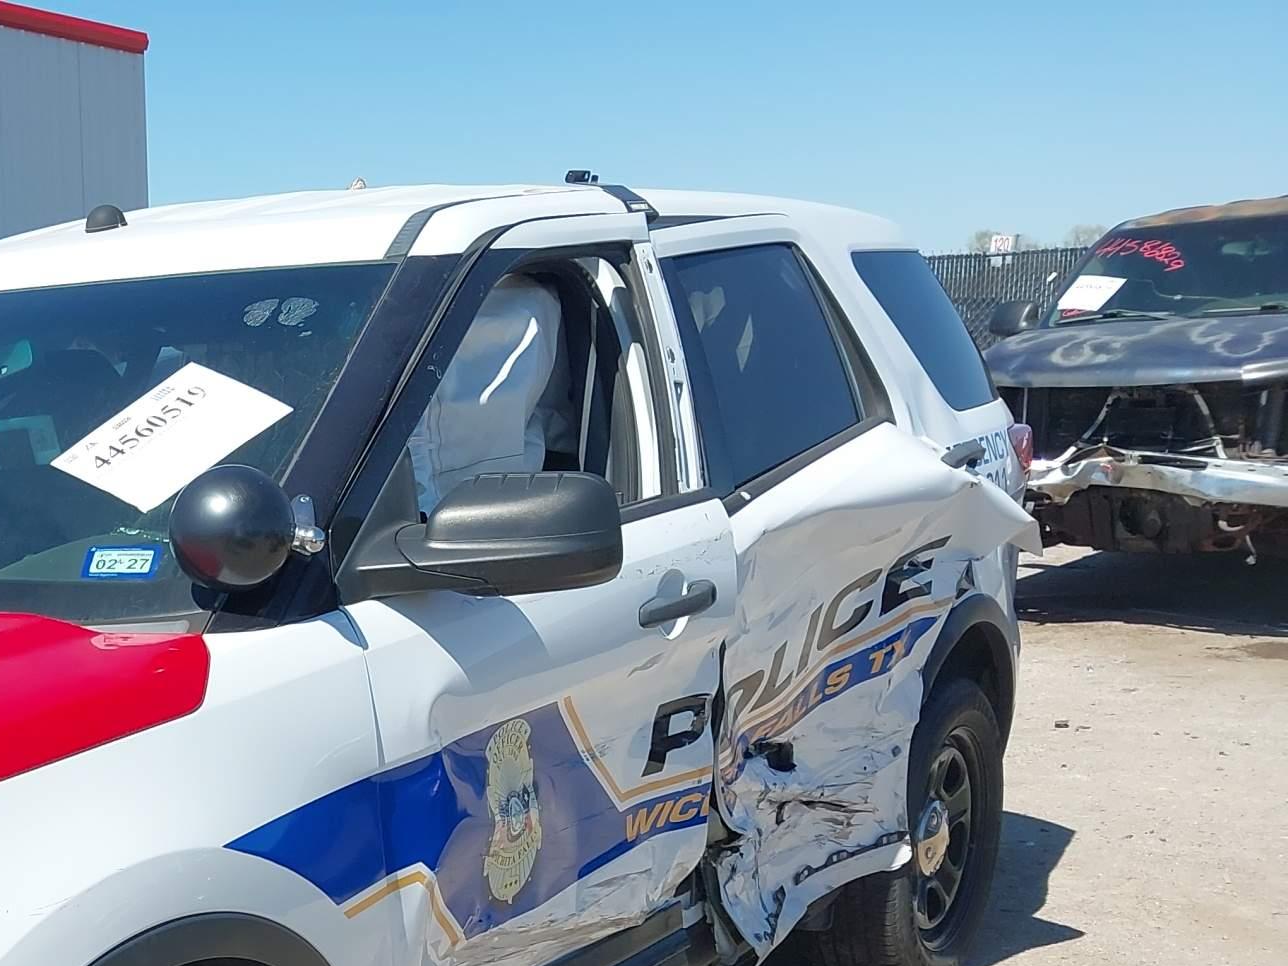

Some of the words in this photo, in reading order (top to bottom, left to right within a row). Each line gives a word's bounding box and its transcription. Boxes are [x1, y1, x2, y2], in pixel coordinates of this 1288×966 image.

[94, 385, 207, 470] 44560519
[95, 558, 118, 570] 02
[125, 558, 151, 570] 27
